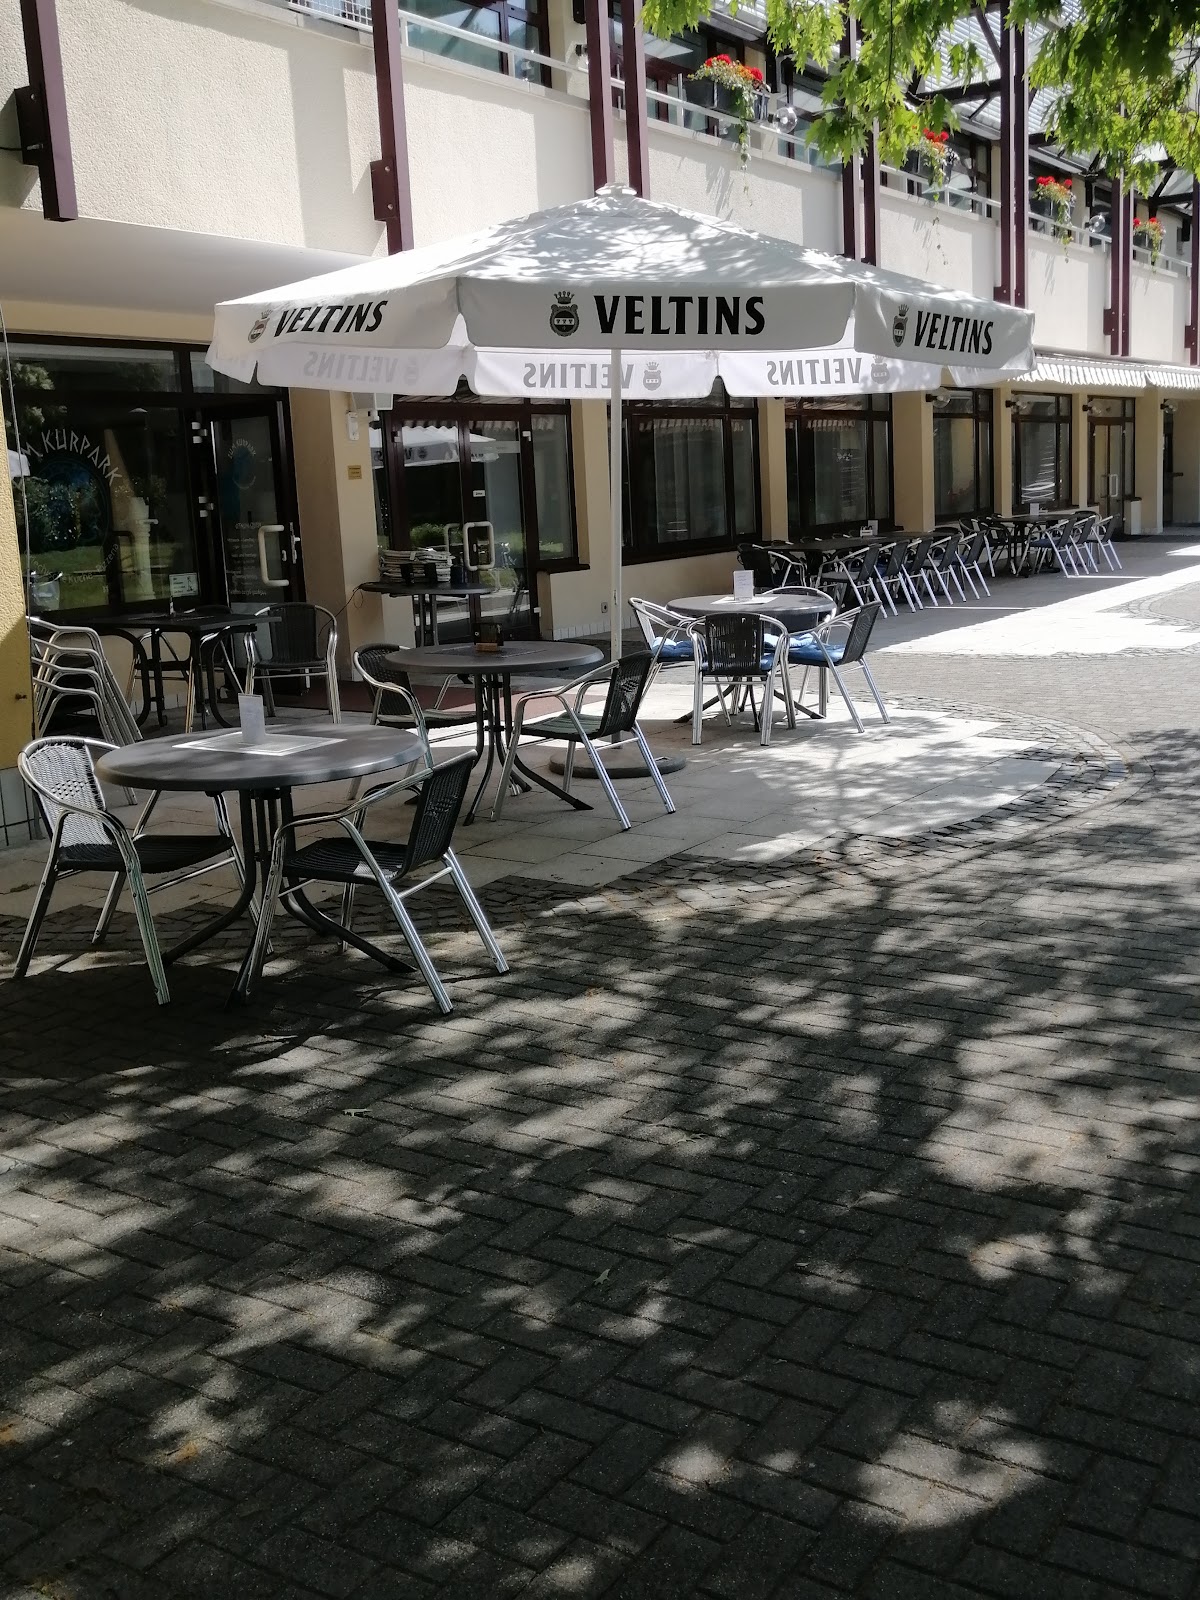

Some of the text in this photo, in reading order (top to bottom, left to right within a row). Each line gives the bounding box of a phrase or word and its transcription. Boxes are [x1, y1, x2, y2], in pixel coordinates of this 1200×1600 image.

[273, 300, 389, 337] VELTINS
[593, 295, 765, 335] VELTINS
[914, 310, 994, 355] VELTINS
[41, 428, 123, 487] KURPARK
